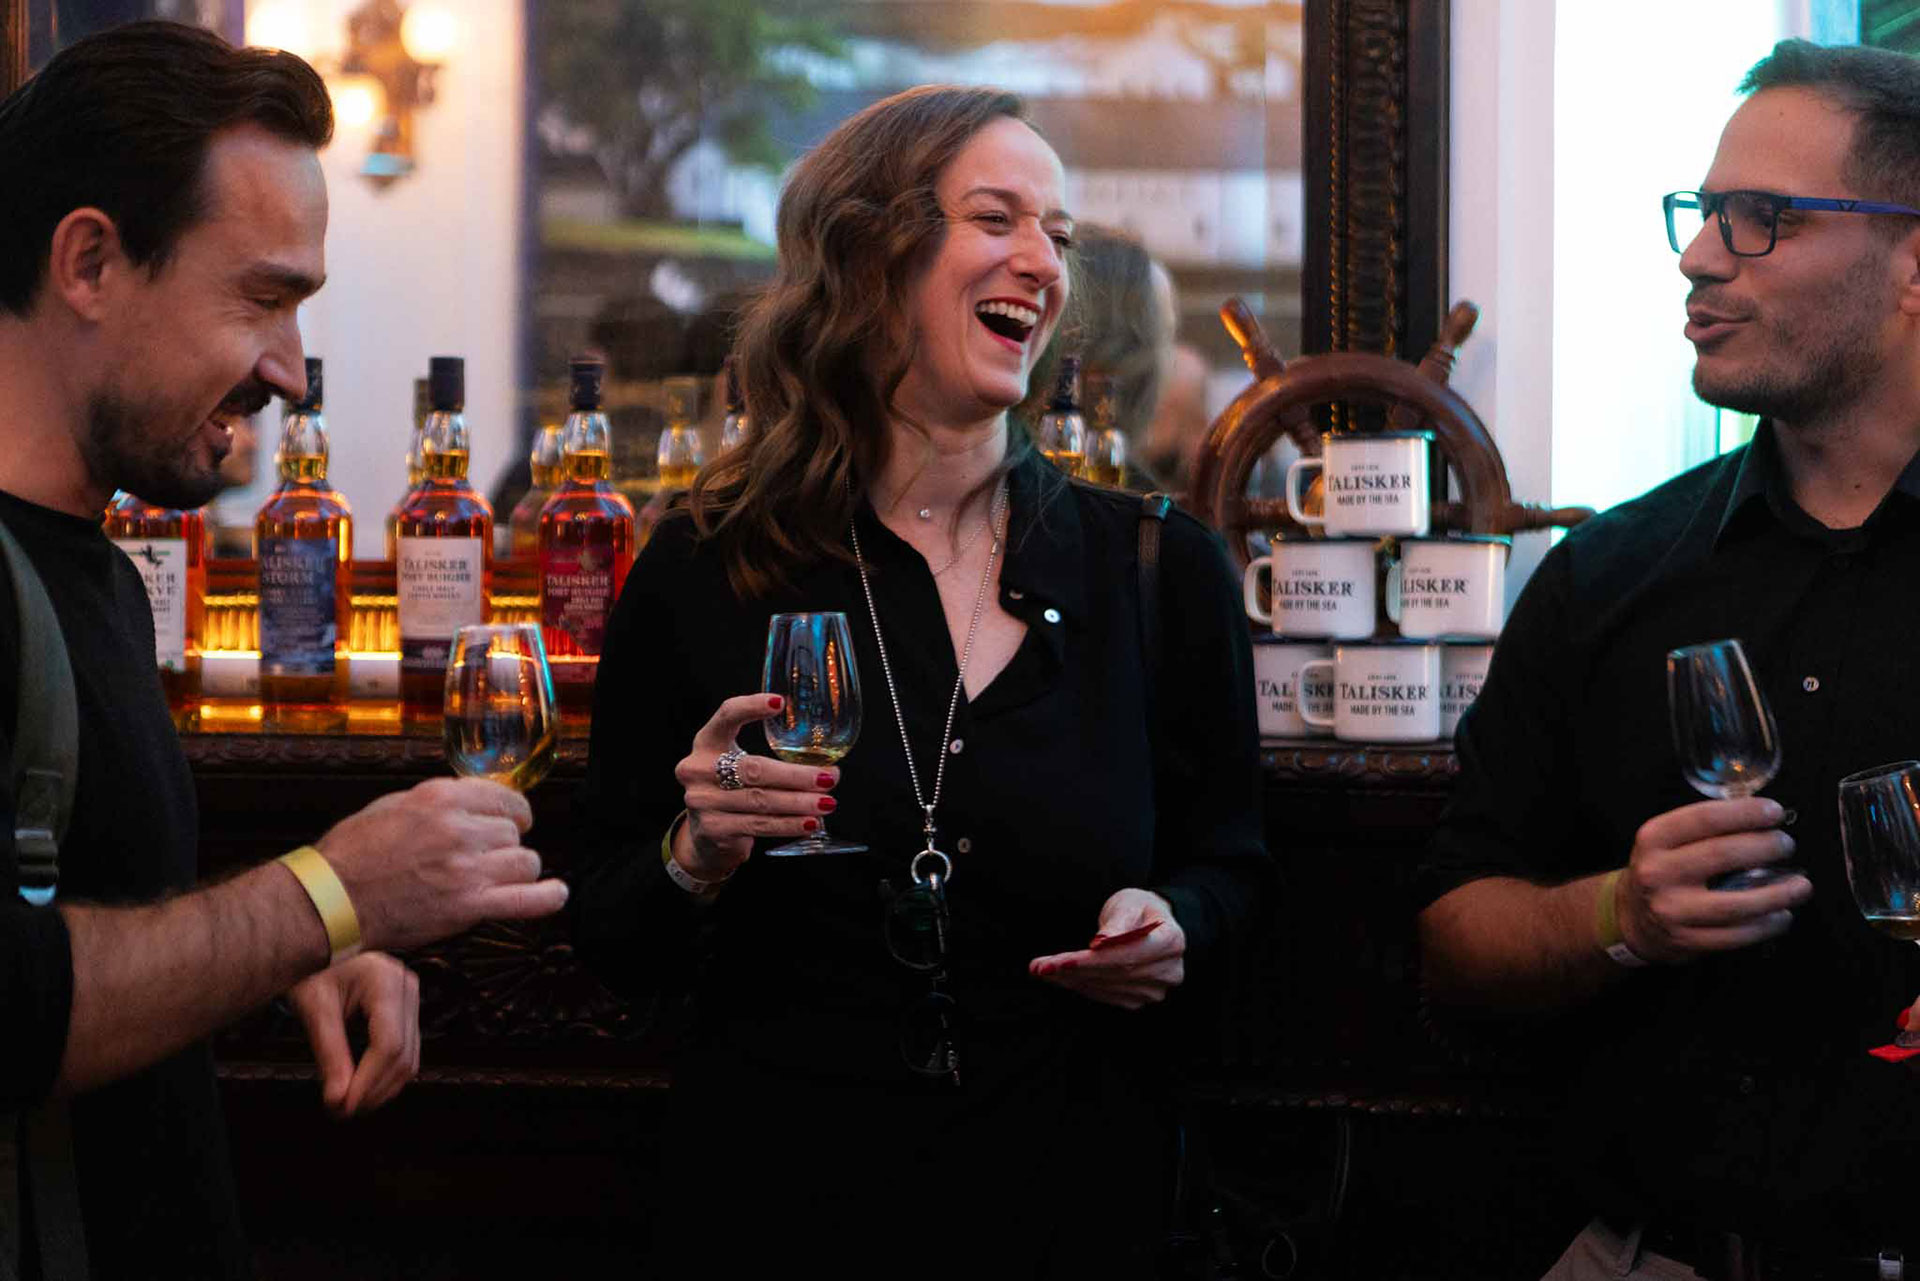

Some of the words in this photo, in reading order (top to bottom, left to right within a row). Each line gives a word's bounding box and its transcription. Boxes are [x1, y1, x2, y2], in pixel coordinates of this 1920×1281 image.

[1328, 472, 1410, 492] TALISKER
[1336, 494, 1354, 505] MADE
[1356, 494, 1366, 503] BY
[1368, 493, 1382, 504] THE
[1385, 492, 1399, 503] SEA
[1322, 600, 1337, 610] SEA
[1340, 682, 1428, 700] TALISKER
[1350, 705, 1369, 716] MADE
[1372, 705, 1382, 715] BY
[1385, 705, 1398, 716] THE
[1401, 705, 1415, 716] SEA
